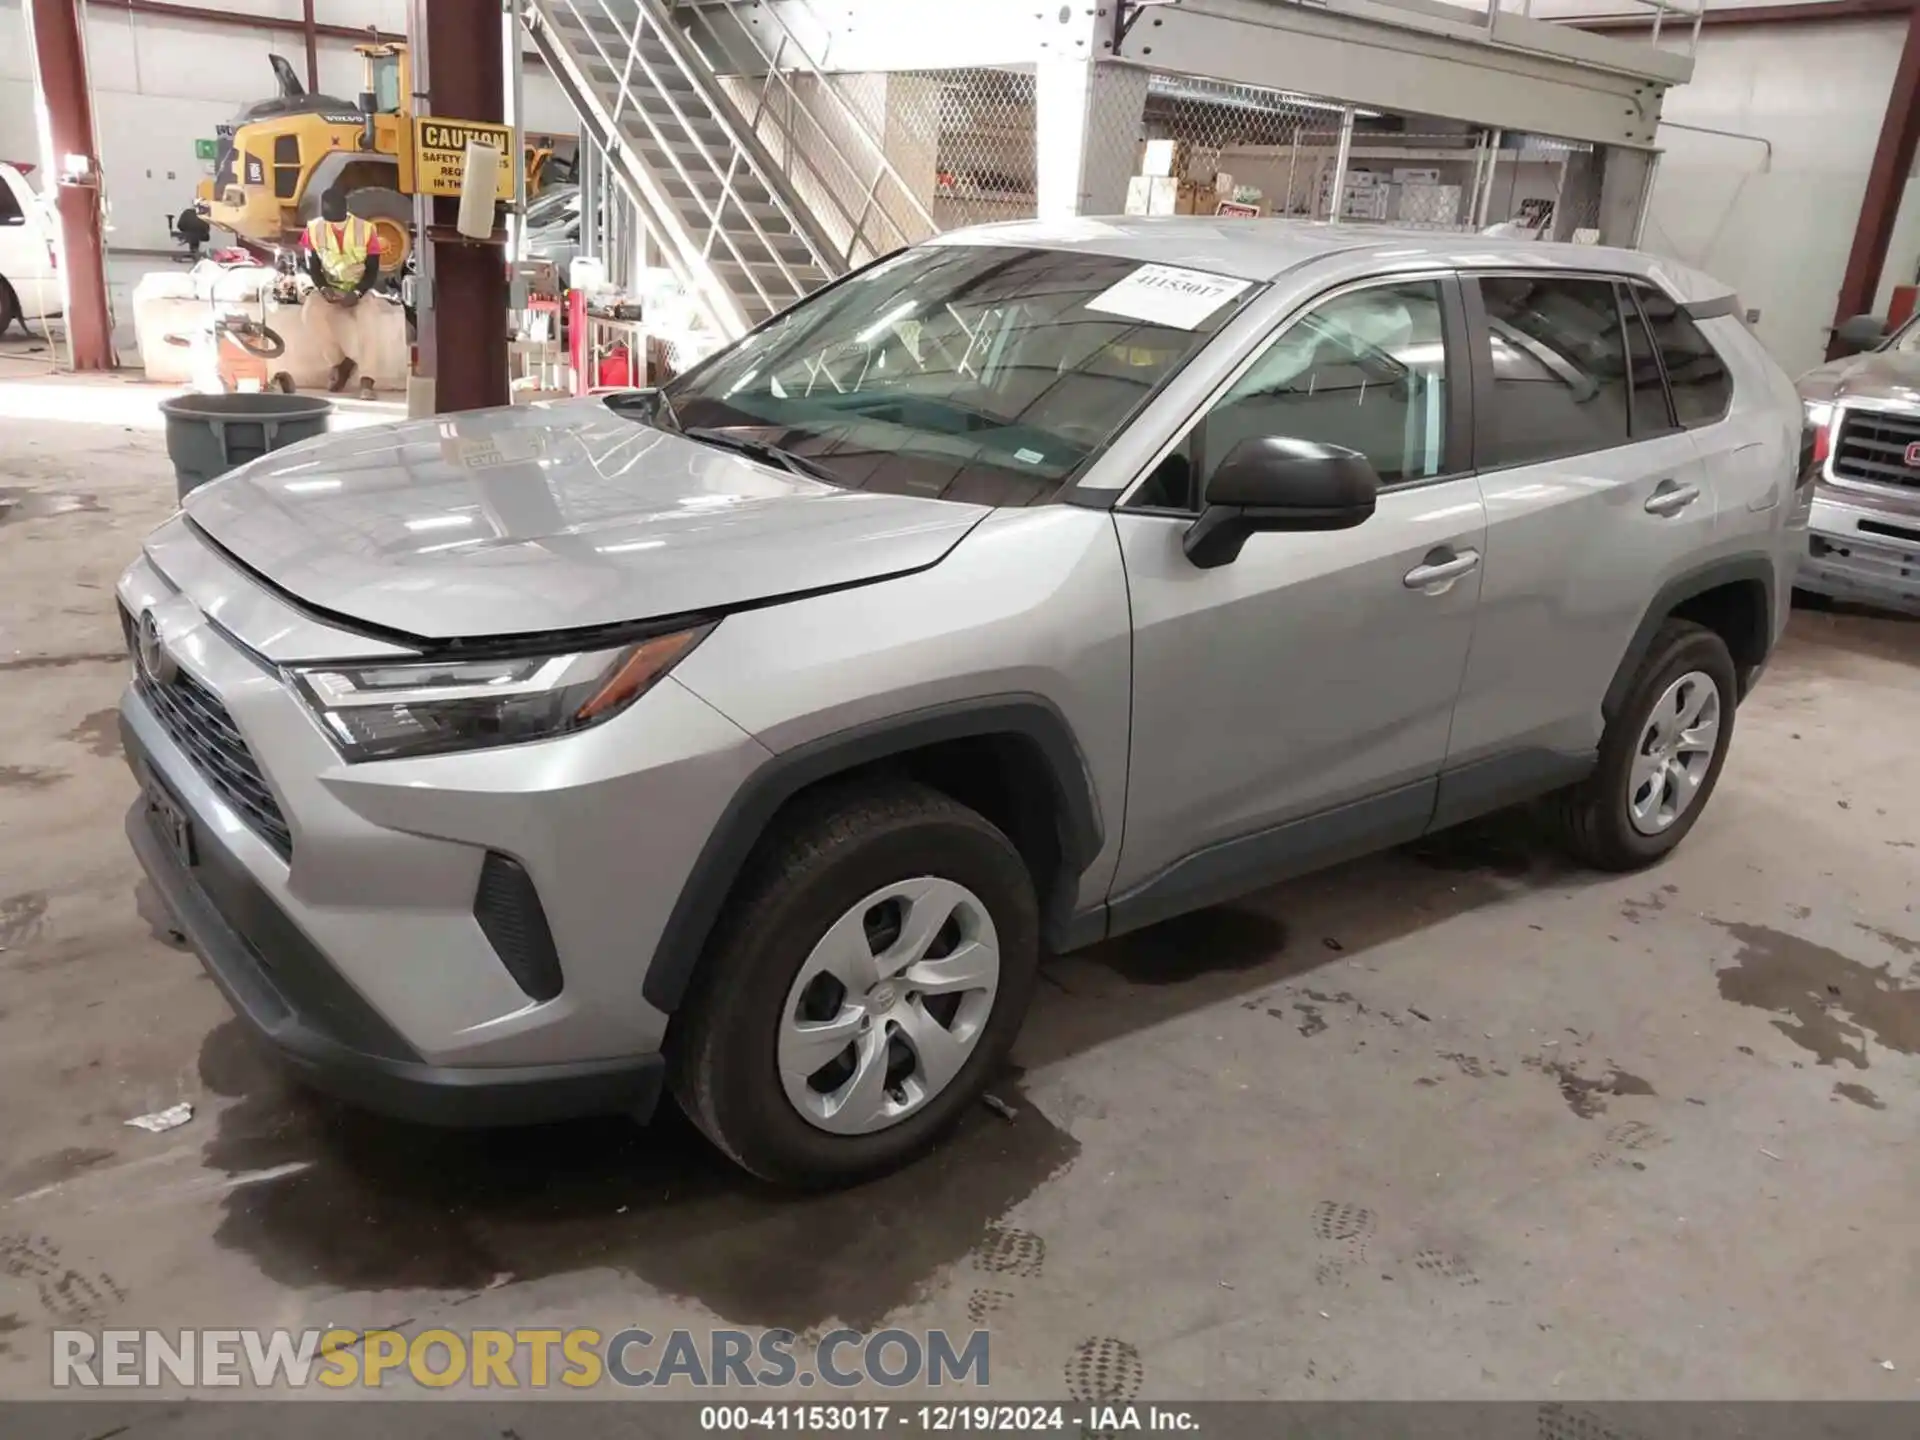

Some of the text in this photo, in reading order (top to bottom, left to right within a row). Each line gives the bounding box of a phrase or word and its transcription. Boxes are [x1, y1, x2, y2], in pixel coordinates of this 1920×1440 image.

[422, 152, 461, 165] SAFETY
[433, 178, 445, 189] IN
[1136, 275, 1225, 298] 41153017
